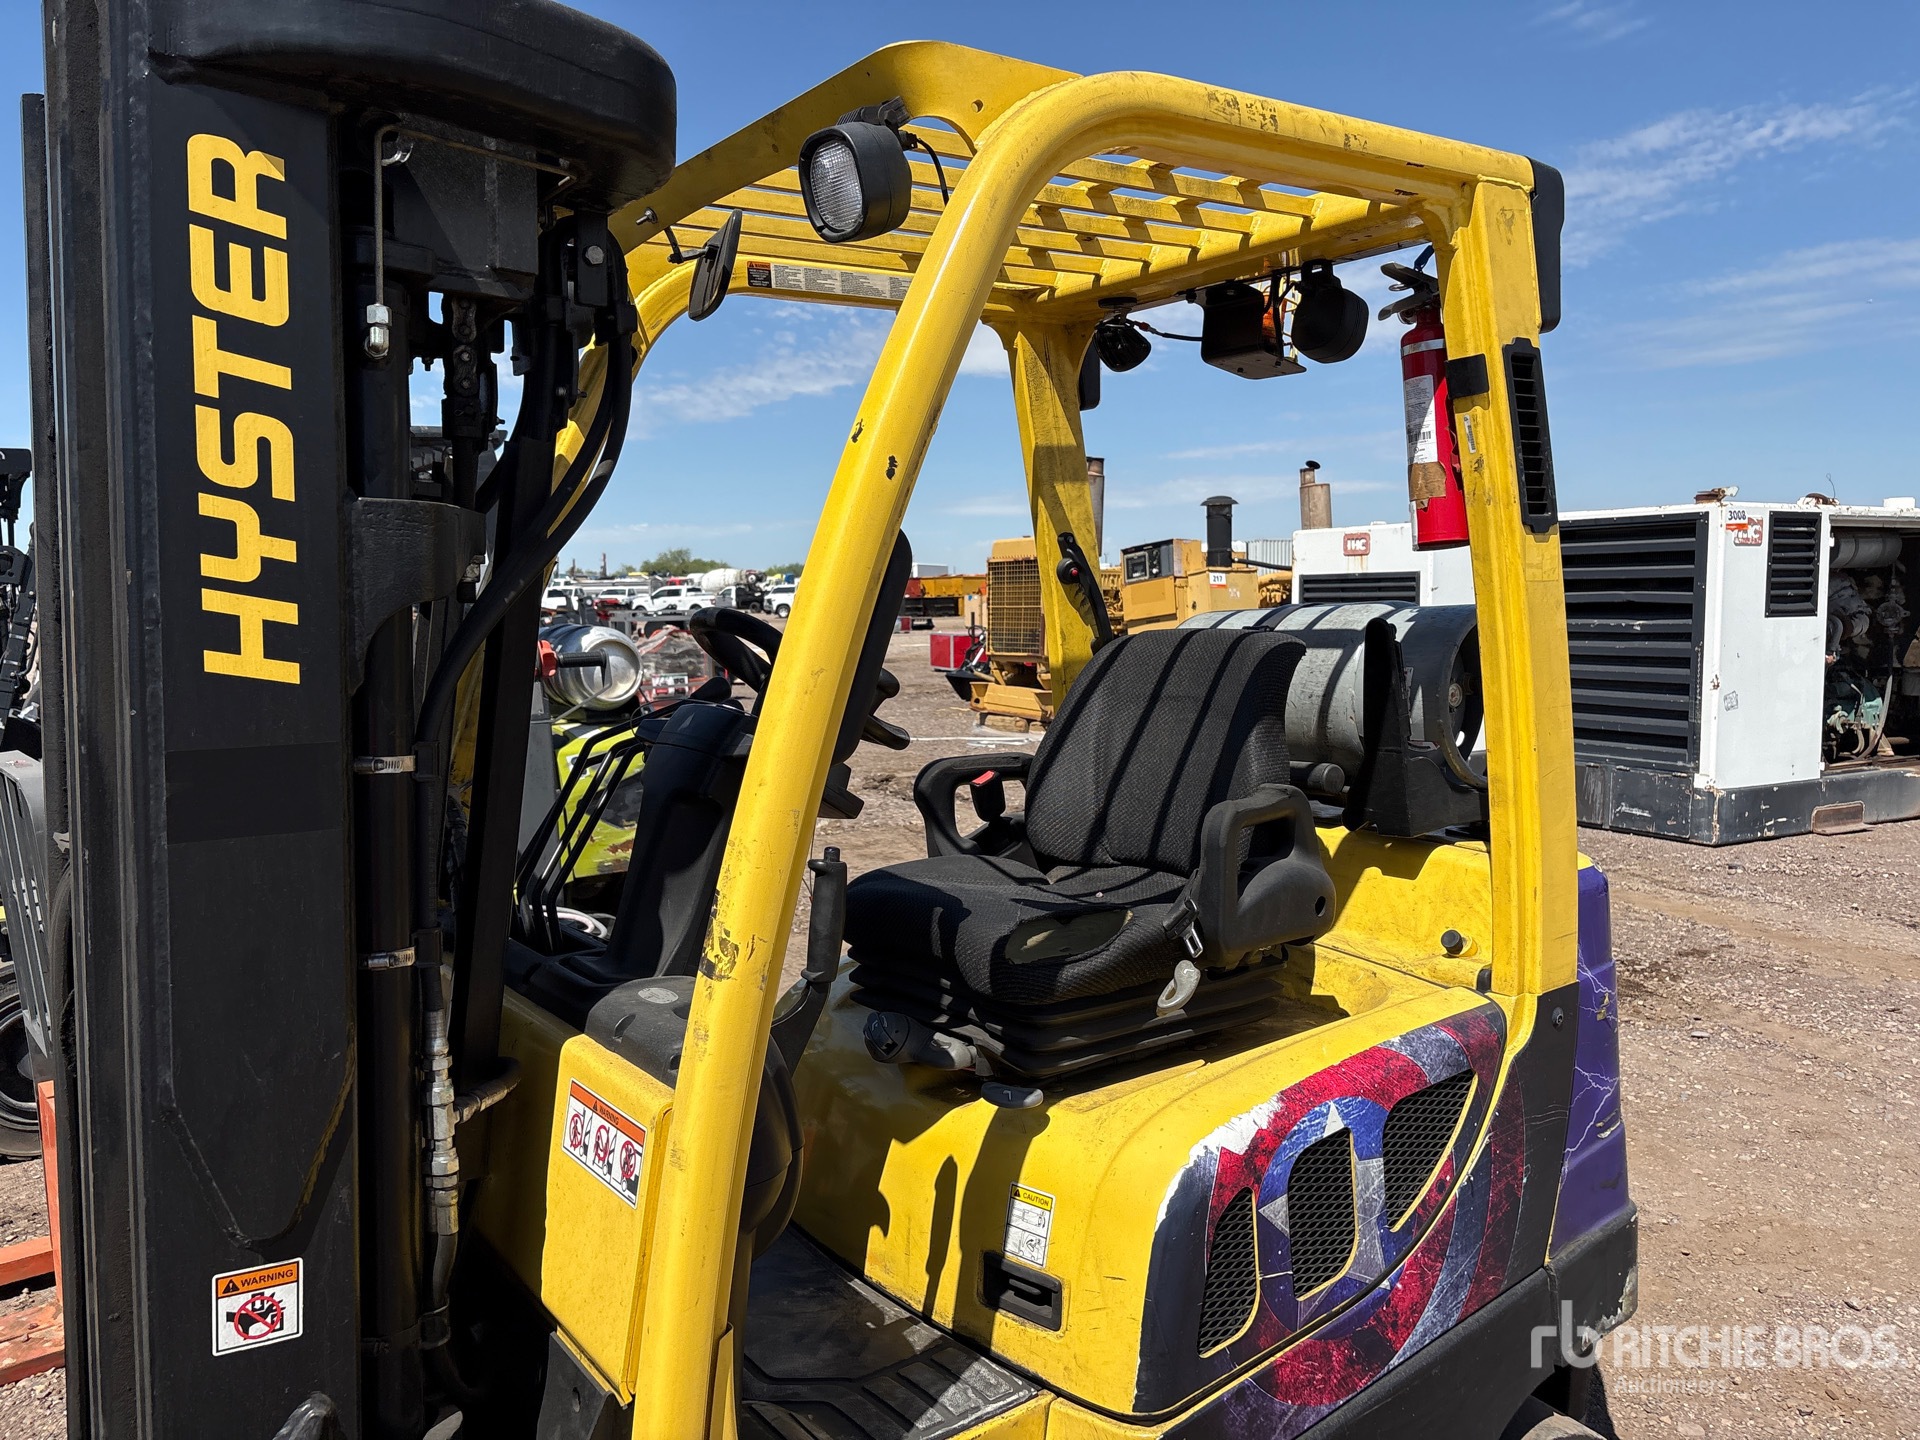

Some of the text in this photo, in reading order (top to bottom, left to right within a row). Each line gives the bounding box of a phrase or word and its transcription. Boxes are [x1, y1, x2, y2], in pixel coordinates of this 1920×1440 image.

[187, 134, 300, 684] HYSTER
[599, 1105, 619, 1125] WARNING
[1023, 1192, 1049, 1207] CAUTION
[241, 1269, 293, 1287] WARNING
